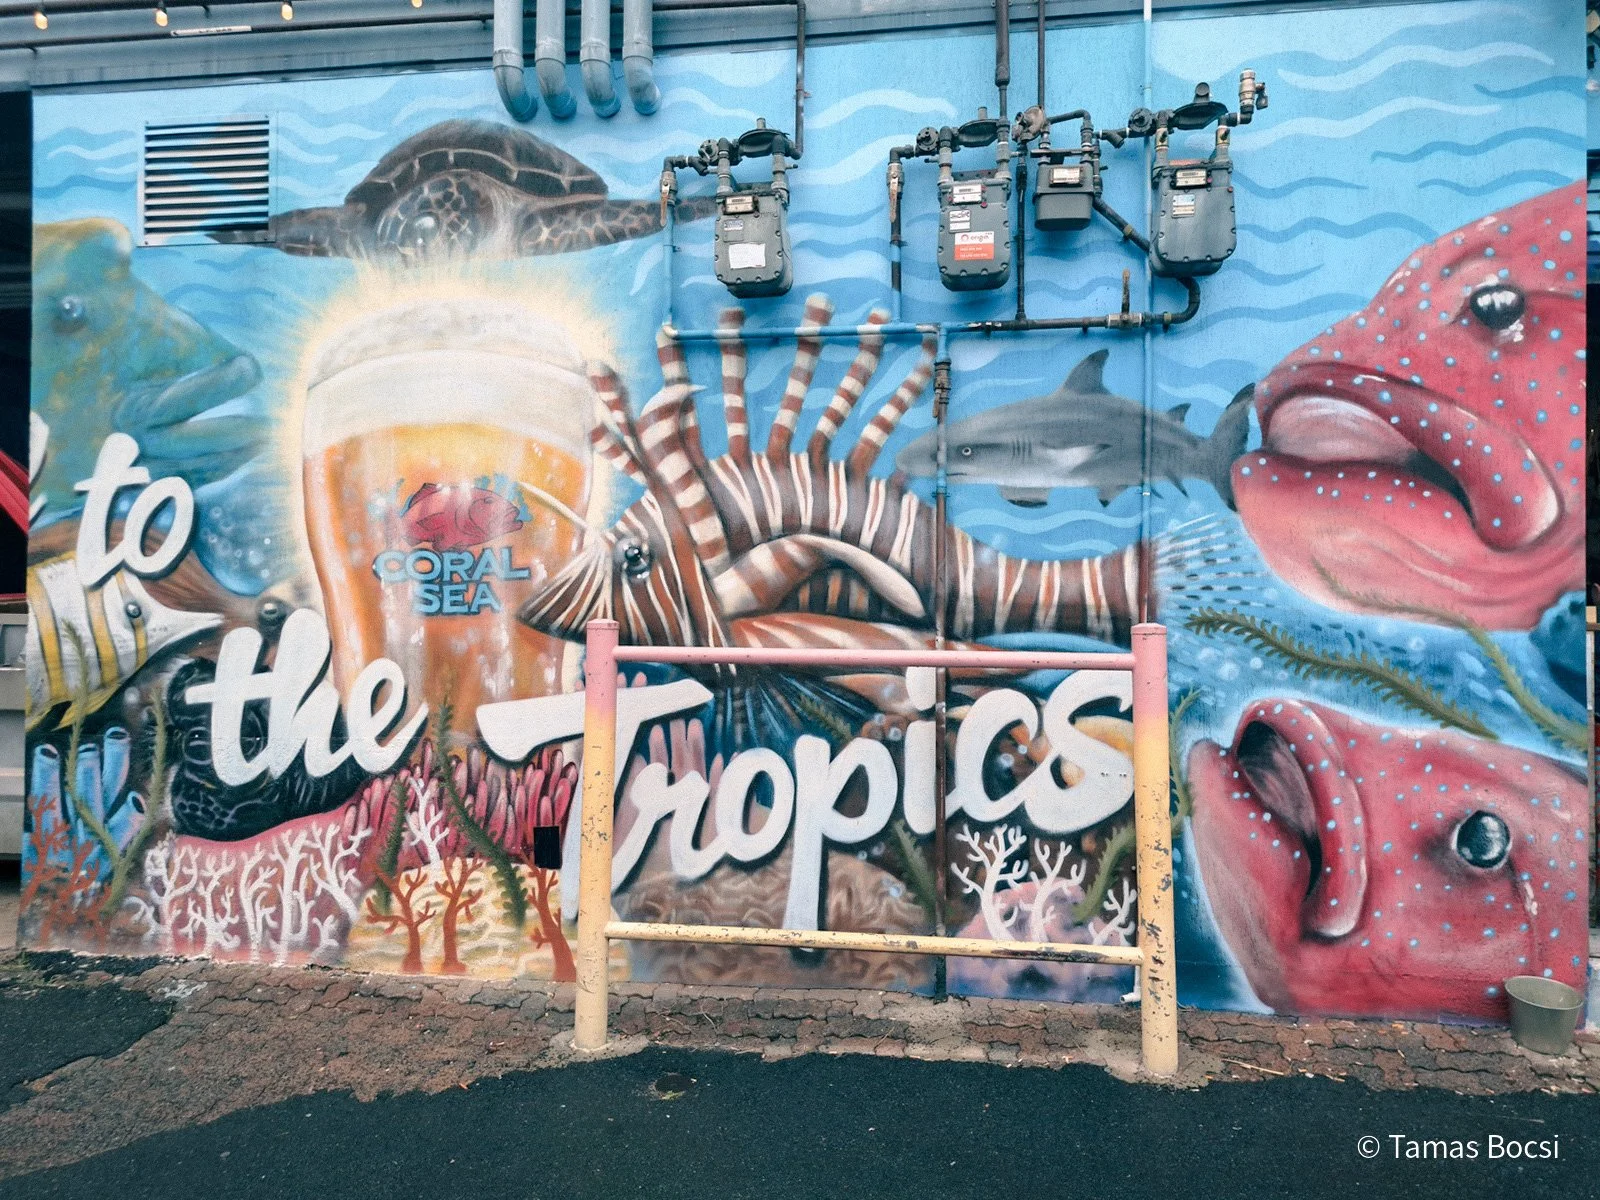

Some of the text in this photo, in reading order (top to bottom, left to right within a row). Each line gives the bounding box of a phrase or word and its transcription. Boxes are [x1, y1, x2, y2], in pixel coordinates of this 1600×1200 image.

[74, 432, 195, 587] to
[373, 547, 530, 583] CORAL
[413, 583, 500, 615] SEA
[186, 608, 428, 786] the
[476, 666, 1136, 950] Tropics
